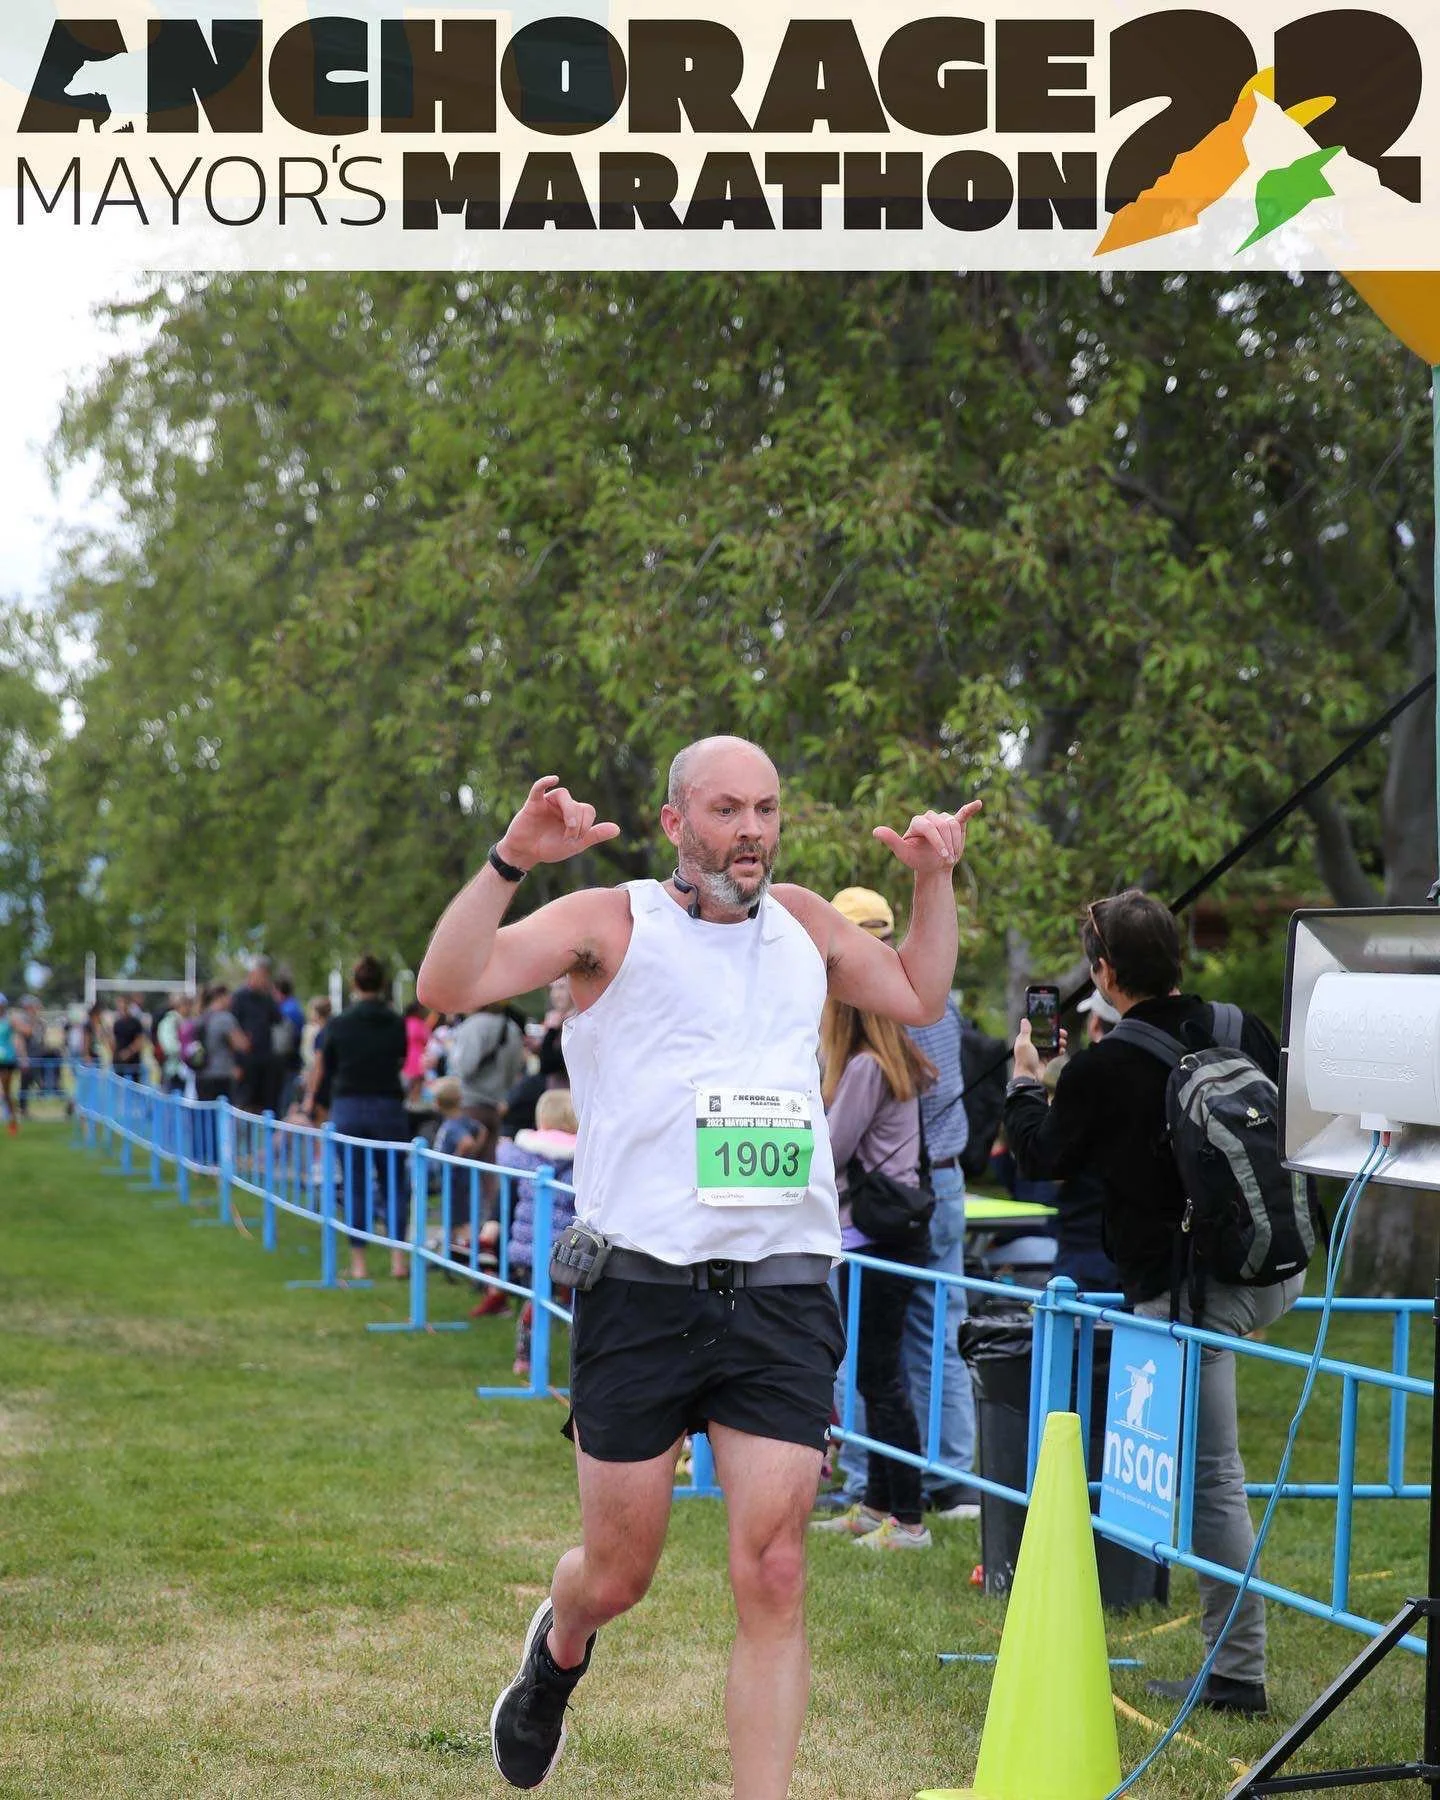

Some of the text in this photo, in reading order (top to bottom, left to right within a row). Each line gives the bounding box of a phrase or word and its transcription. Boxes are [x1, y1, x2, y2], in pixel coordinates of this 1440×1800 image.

[706, 1118, 724, 1128] 2022
[755, 1118, 772, 1128] HALF
[715, 1141, 800, 1177] 1903
[1103, 1430, 1174, 1502] nsaa
